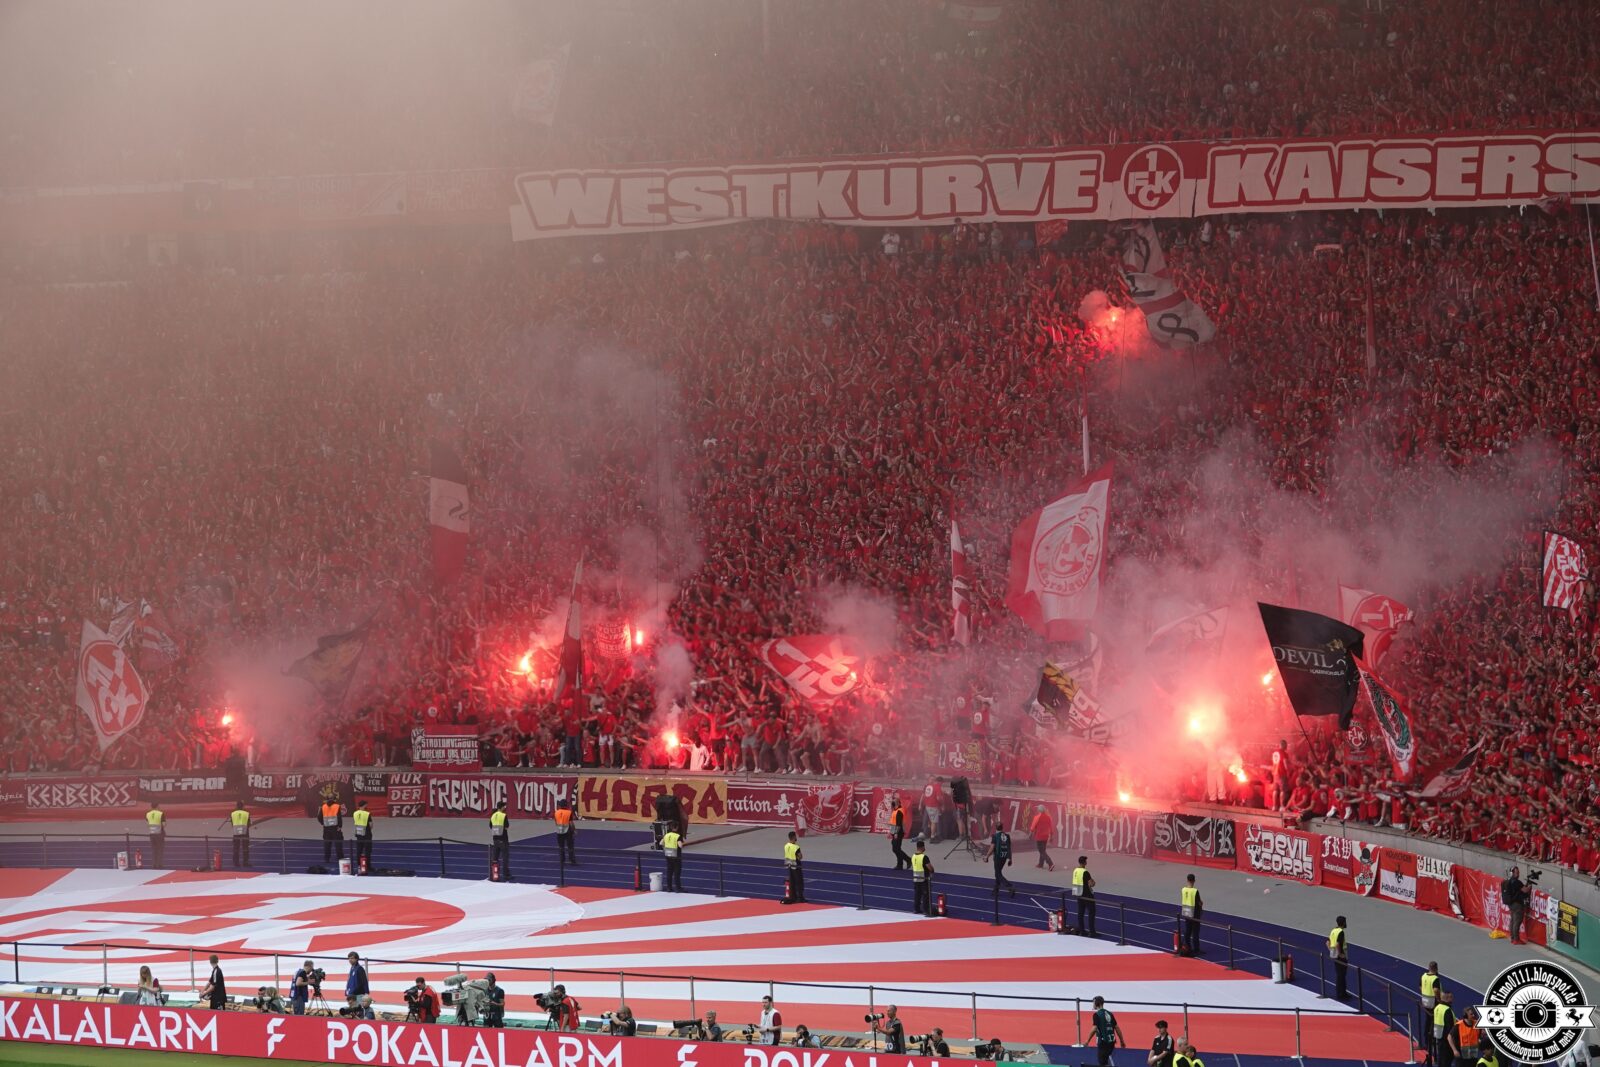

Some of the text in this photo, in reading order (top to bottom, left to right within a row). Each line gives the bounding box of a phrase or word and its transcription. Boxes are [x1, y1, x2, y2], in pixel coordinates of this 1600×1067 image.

[522, 158, 1100, 231] WESTKURVE
[1273, 646, 1334, 668] DEVIL
[390, 772, 422, 785] NUR
[27, 783, 131, 807] KERBEROS
[390, 788, 422, 801] DER
[429, 777, 507, 812] FRENETIC
[391, 804, 421, 818] FCK
[1260, 853, 1314, 881] CORPS
[0, 1000, 218, 1053] KALALARM
[326, 1020, 623, 1067] POKALALARM
